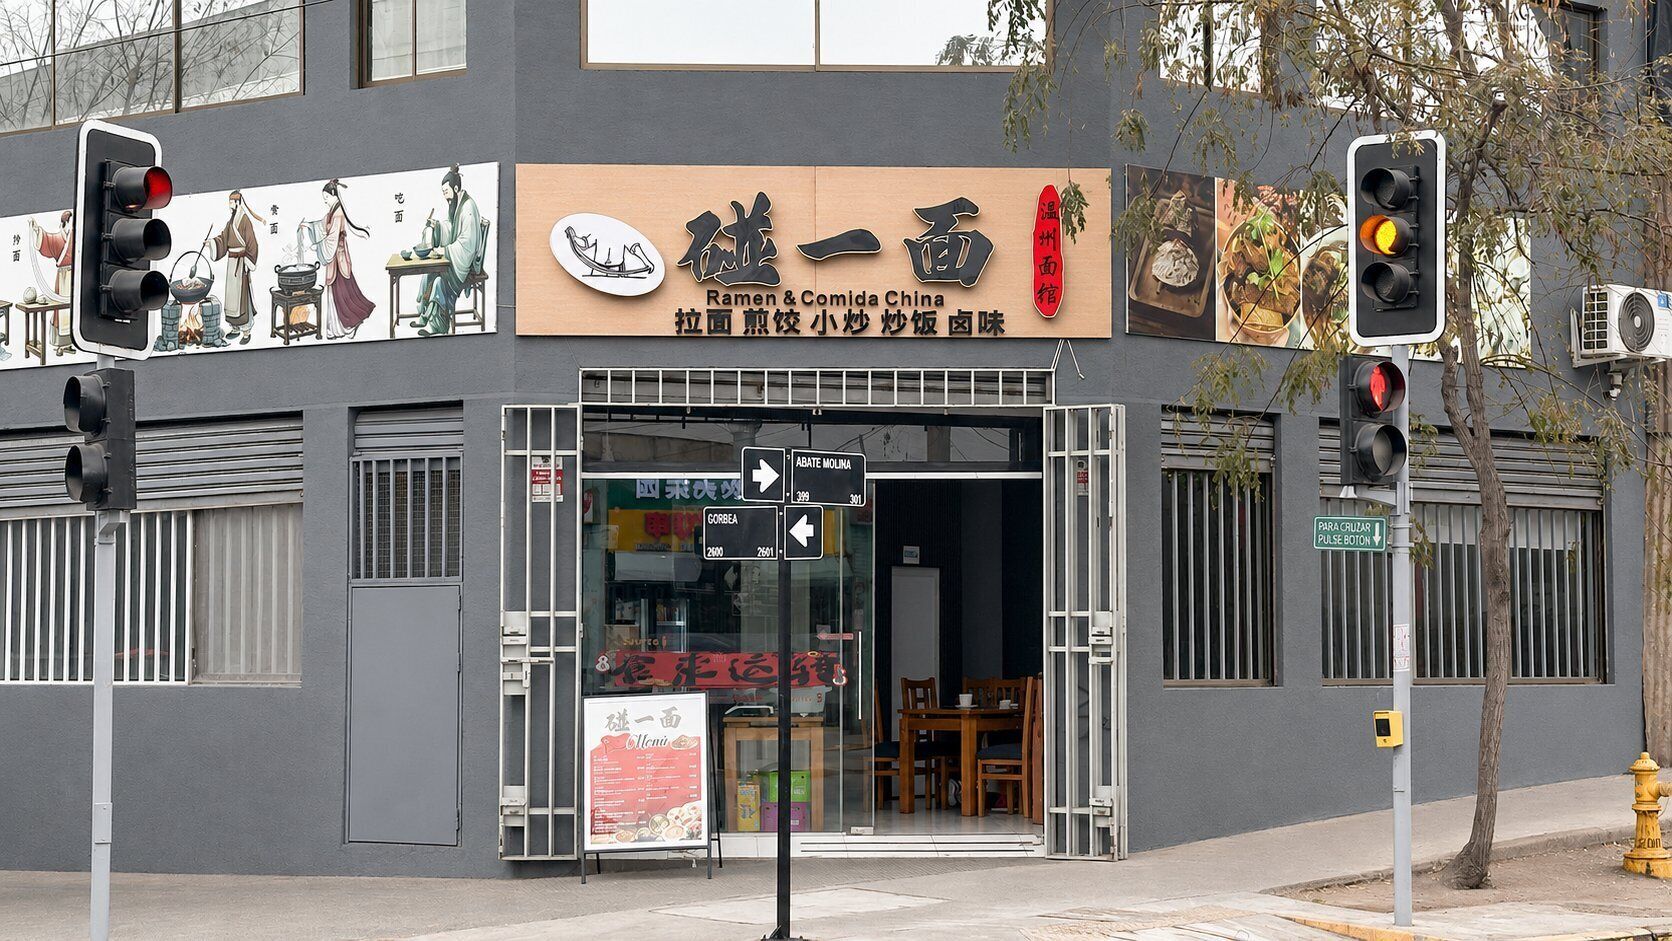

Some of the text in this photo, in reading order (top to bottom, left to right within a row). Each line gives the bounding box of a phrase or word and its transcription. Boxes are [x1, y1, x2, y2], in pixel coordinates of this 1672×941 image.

[676, 191, 995, 287] 碰一面
[1037, 201, 1060, 305] 温州面馆
[706, 289, 945, 307] Ramen & Comida China
[675, 308, 1006, 336] 拉面 煎饺 小炒 炒饭 卤味
[795, 456, 851, 470] ABATE MOLINA
[796, 491, 862, 505] 399 301
[707, 513, 738, 525] GORBEA
[1318, 521, 1371, 533] PARA CRUZAR
[1318, 534, 1371, 546] PULSE BOTON
[707, 546, 724, 557] 2600
[757, 546, 774, 557] 2601
[605, 706, 682, 732] 碰一面
